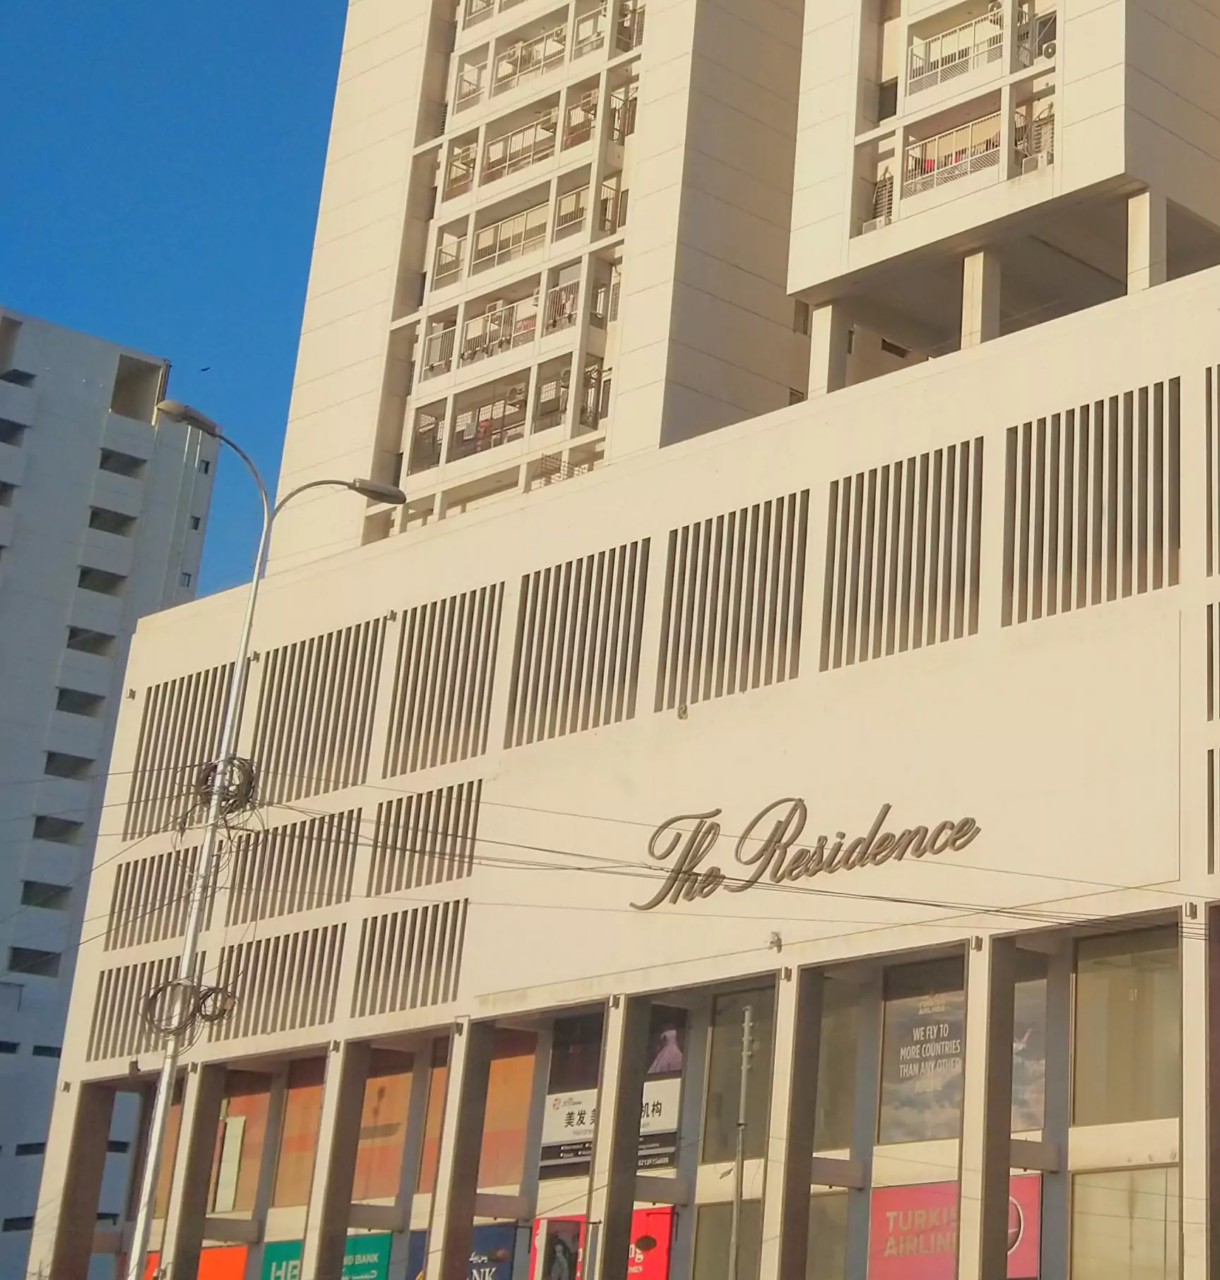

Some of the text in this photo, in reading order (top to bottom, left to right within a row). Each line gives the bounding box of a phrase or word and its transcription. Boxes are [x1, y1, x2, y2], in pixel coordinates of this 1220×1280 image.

[629, 797, 982, 911] The Residence
[913, 1023, 949, 1041] WE FLY TO
[900, 1040, 961, 1060] MORE COUNTRIES
[899, 1063, 919, 1078] THAN
[920, 1060, 936, 1076] ANY
